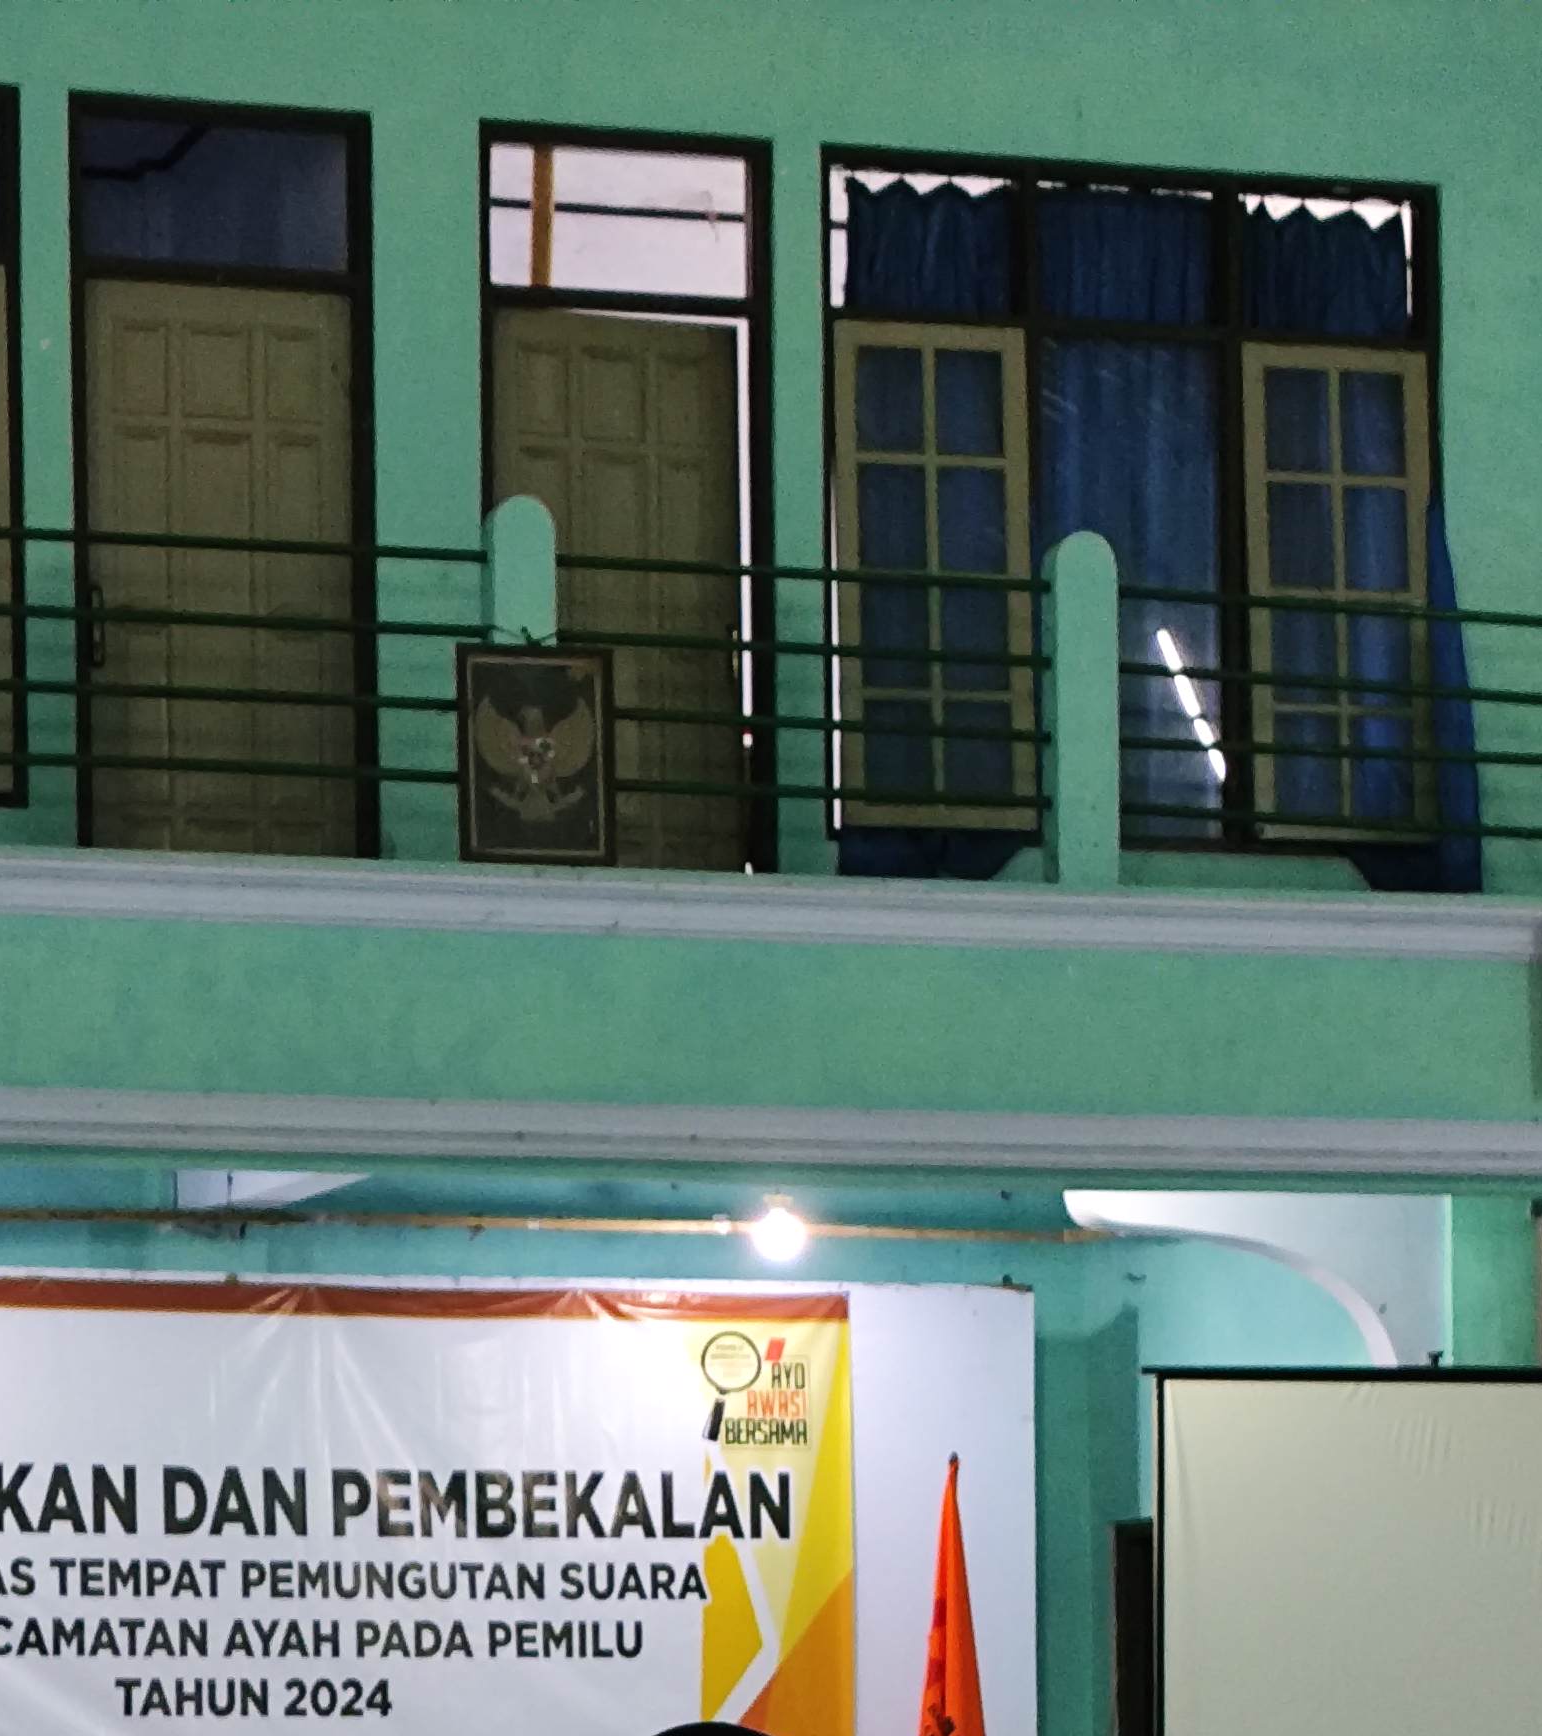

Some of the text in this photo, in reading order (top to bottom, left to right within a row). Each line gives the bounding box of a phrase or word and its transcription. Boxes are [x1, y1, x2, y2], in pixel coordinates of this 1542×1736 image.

[771, 1361, 806, 1390] AYO
[746, 1391, 808, 1419] AWASI
[724, 1418, 808, 1446] BERSAMA
[162, 1466, 309, 1537] DAN
[331, 1469, 792, 1541] PEMBEKALAN
[49, 1557, 227, 1599] TEMPAT
[241, 1559, 547, 1601] PEMUNGUTAN
[560, 1562, 708, 1602] SUARA
[223, 1619, 341, 1659] AYAH
[355, 1620, 475, 1659] PADA
[488, 1621, 644, 1660] PEMILU
[115, 1678, 393, 1718] TAHUN 2024
